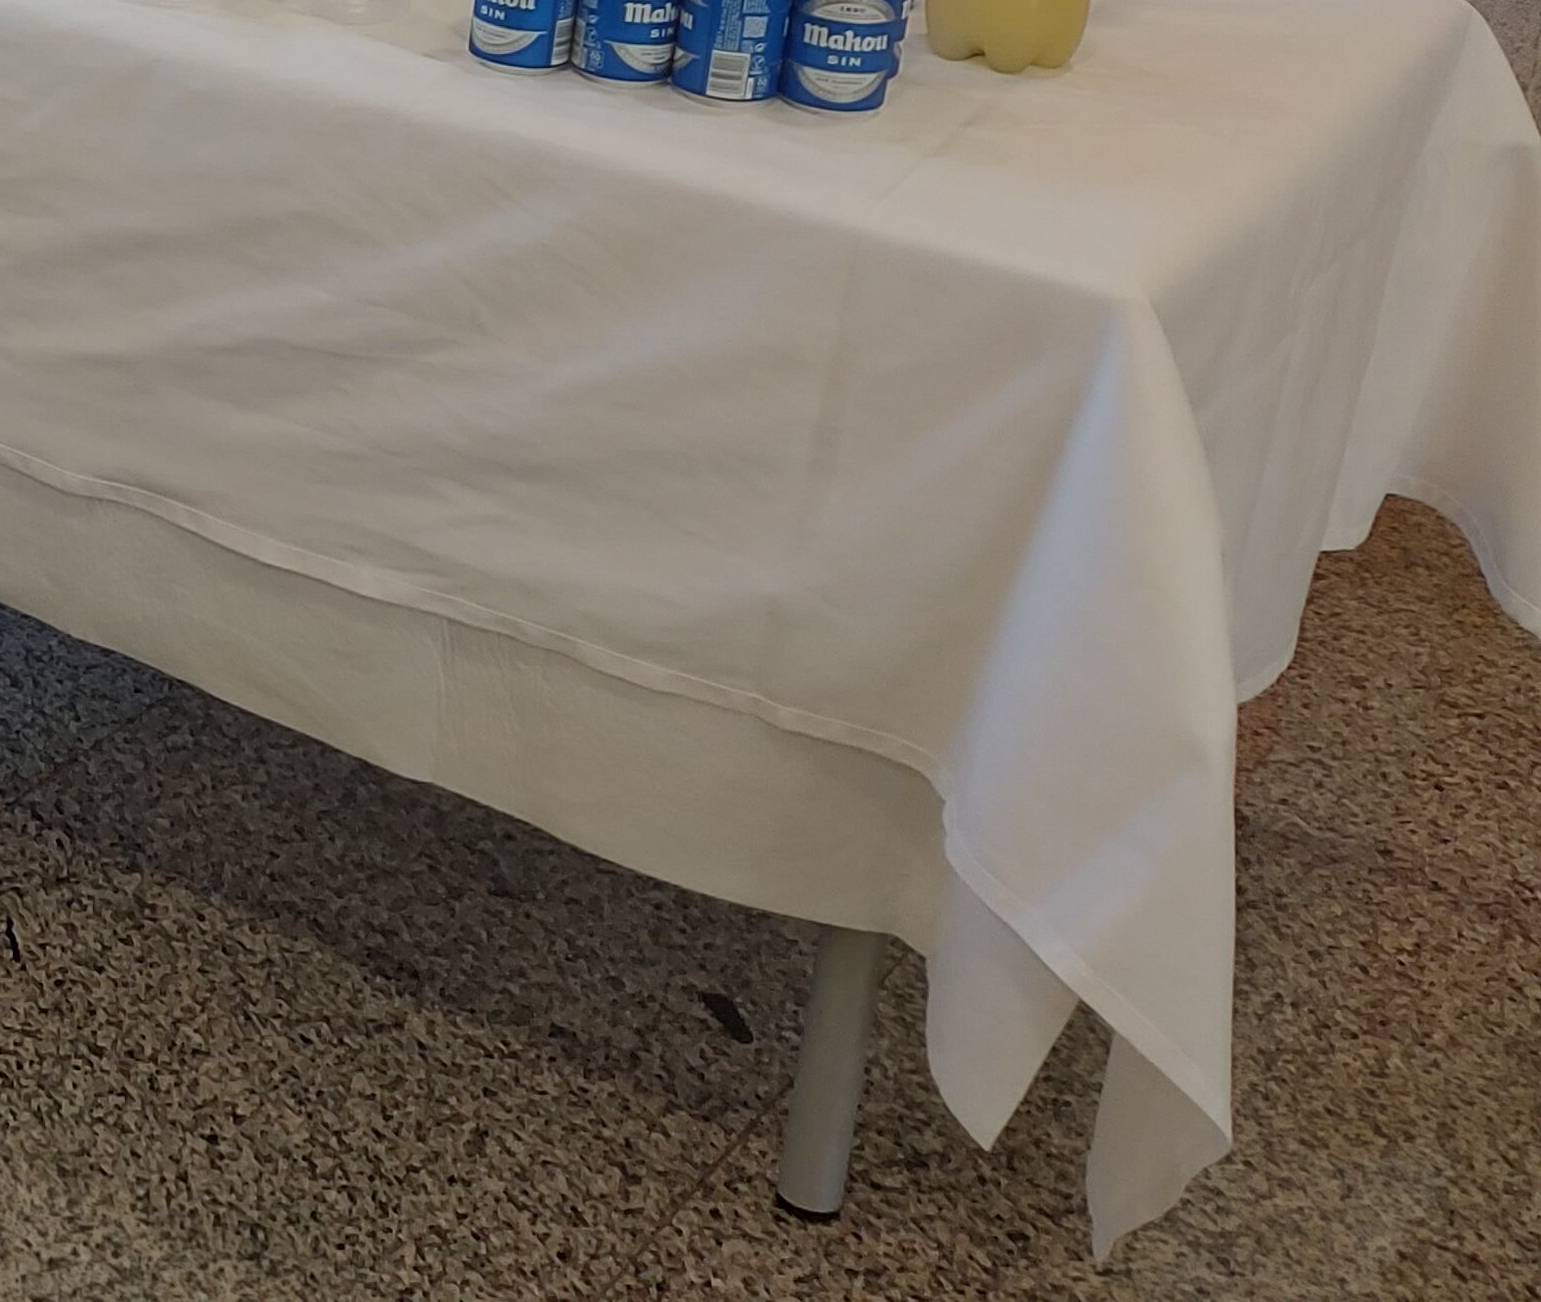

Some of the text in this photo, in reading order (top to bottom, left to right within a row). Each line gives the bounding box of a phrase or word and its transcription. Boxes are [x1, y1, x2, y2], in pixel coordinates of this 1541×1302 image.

[480, 4, 505, 21] SIN
[803, 22, 889, 52] Mahou
[827, 54, 862, 67] SIN
